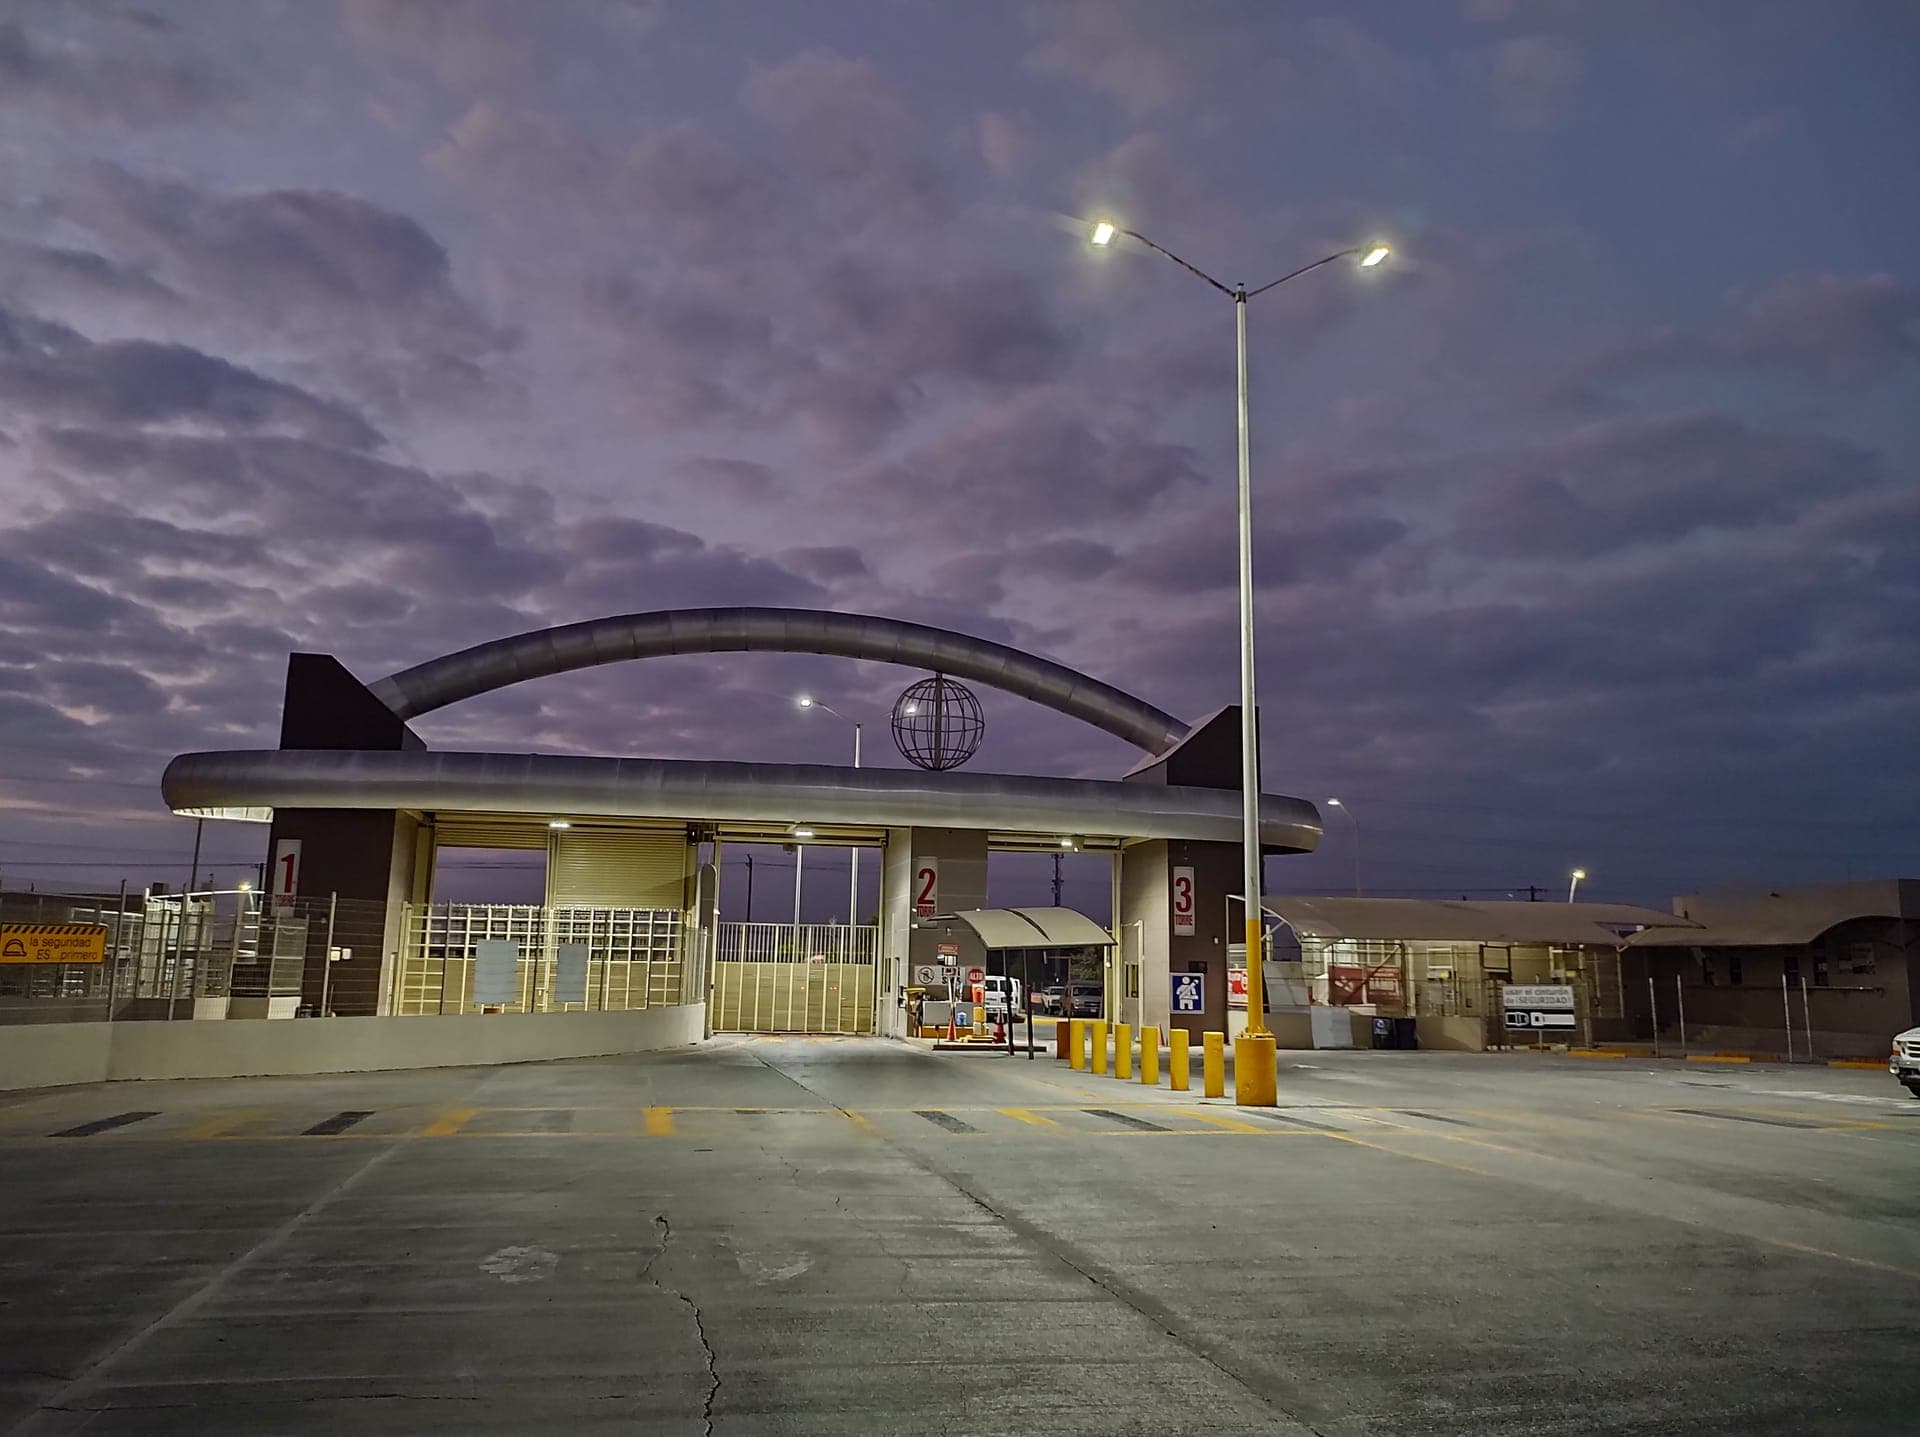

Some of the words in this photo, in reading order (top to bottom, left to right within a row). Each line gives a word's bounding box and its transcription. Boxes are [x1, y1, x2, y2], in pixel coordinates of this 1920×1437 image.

[281, 853, 295, 893] 1
[917, 868, 936, 904] 2
[1175, 876, 1192, 913] 3
[30, 937, 39, 947] la
[42, 938, 91, 949] seguridad
[37, 949, 51, 960] ES
